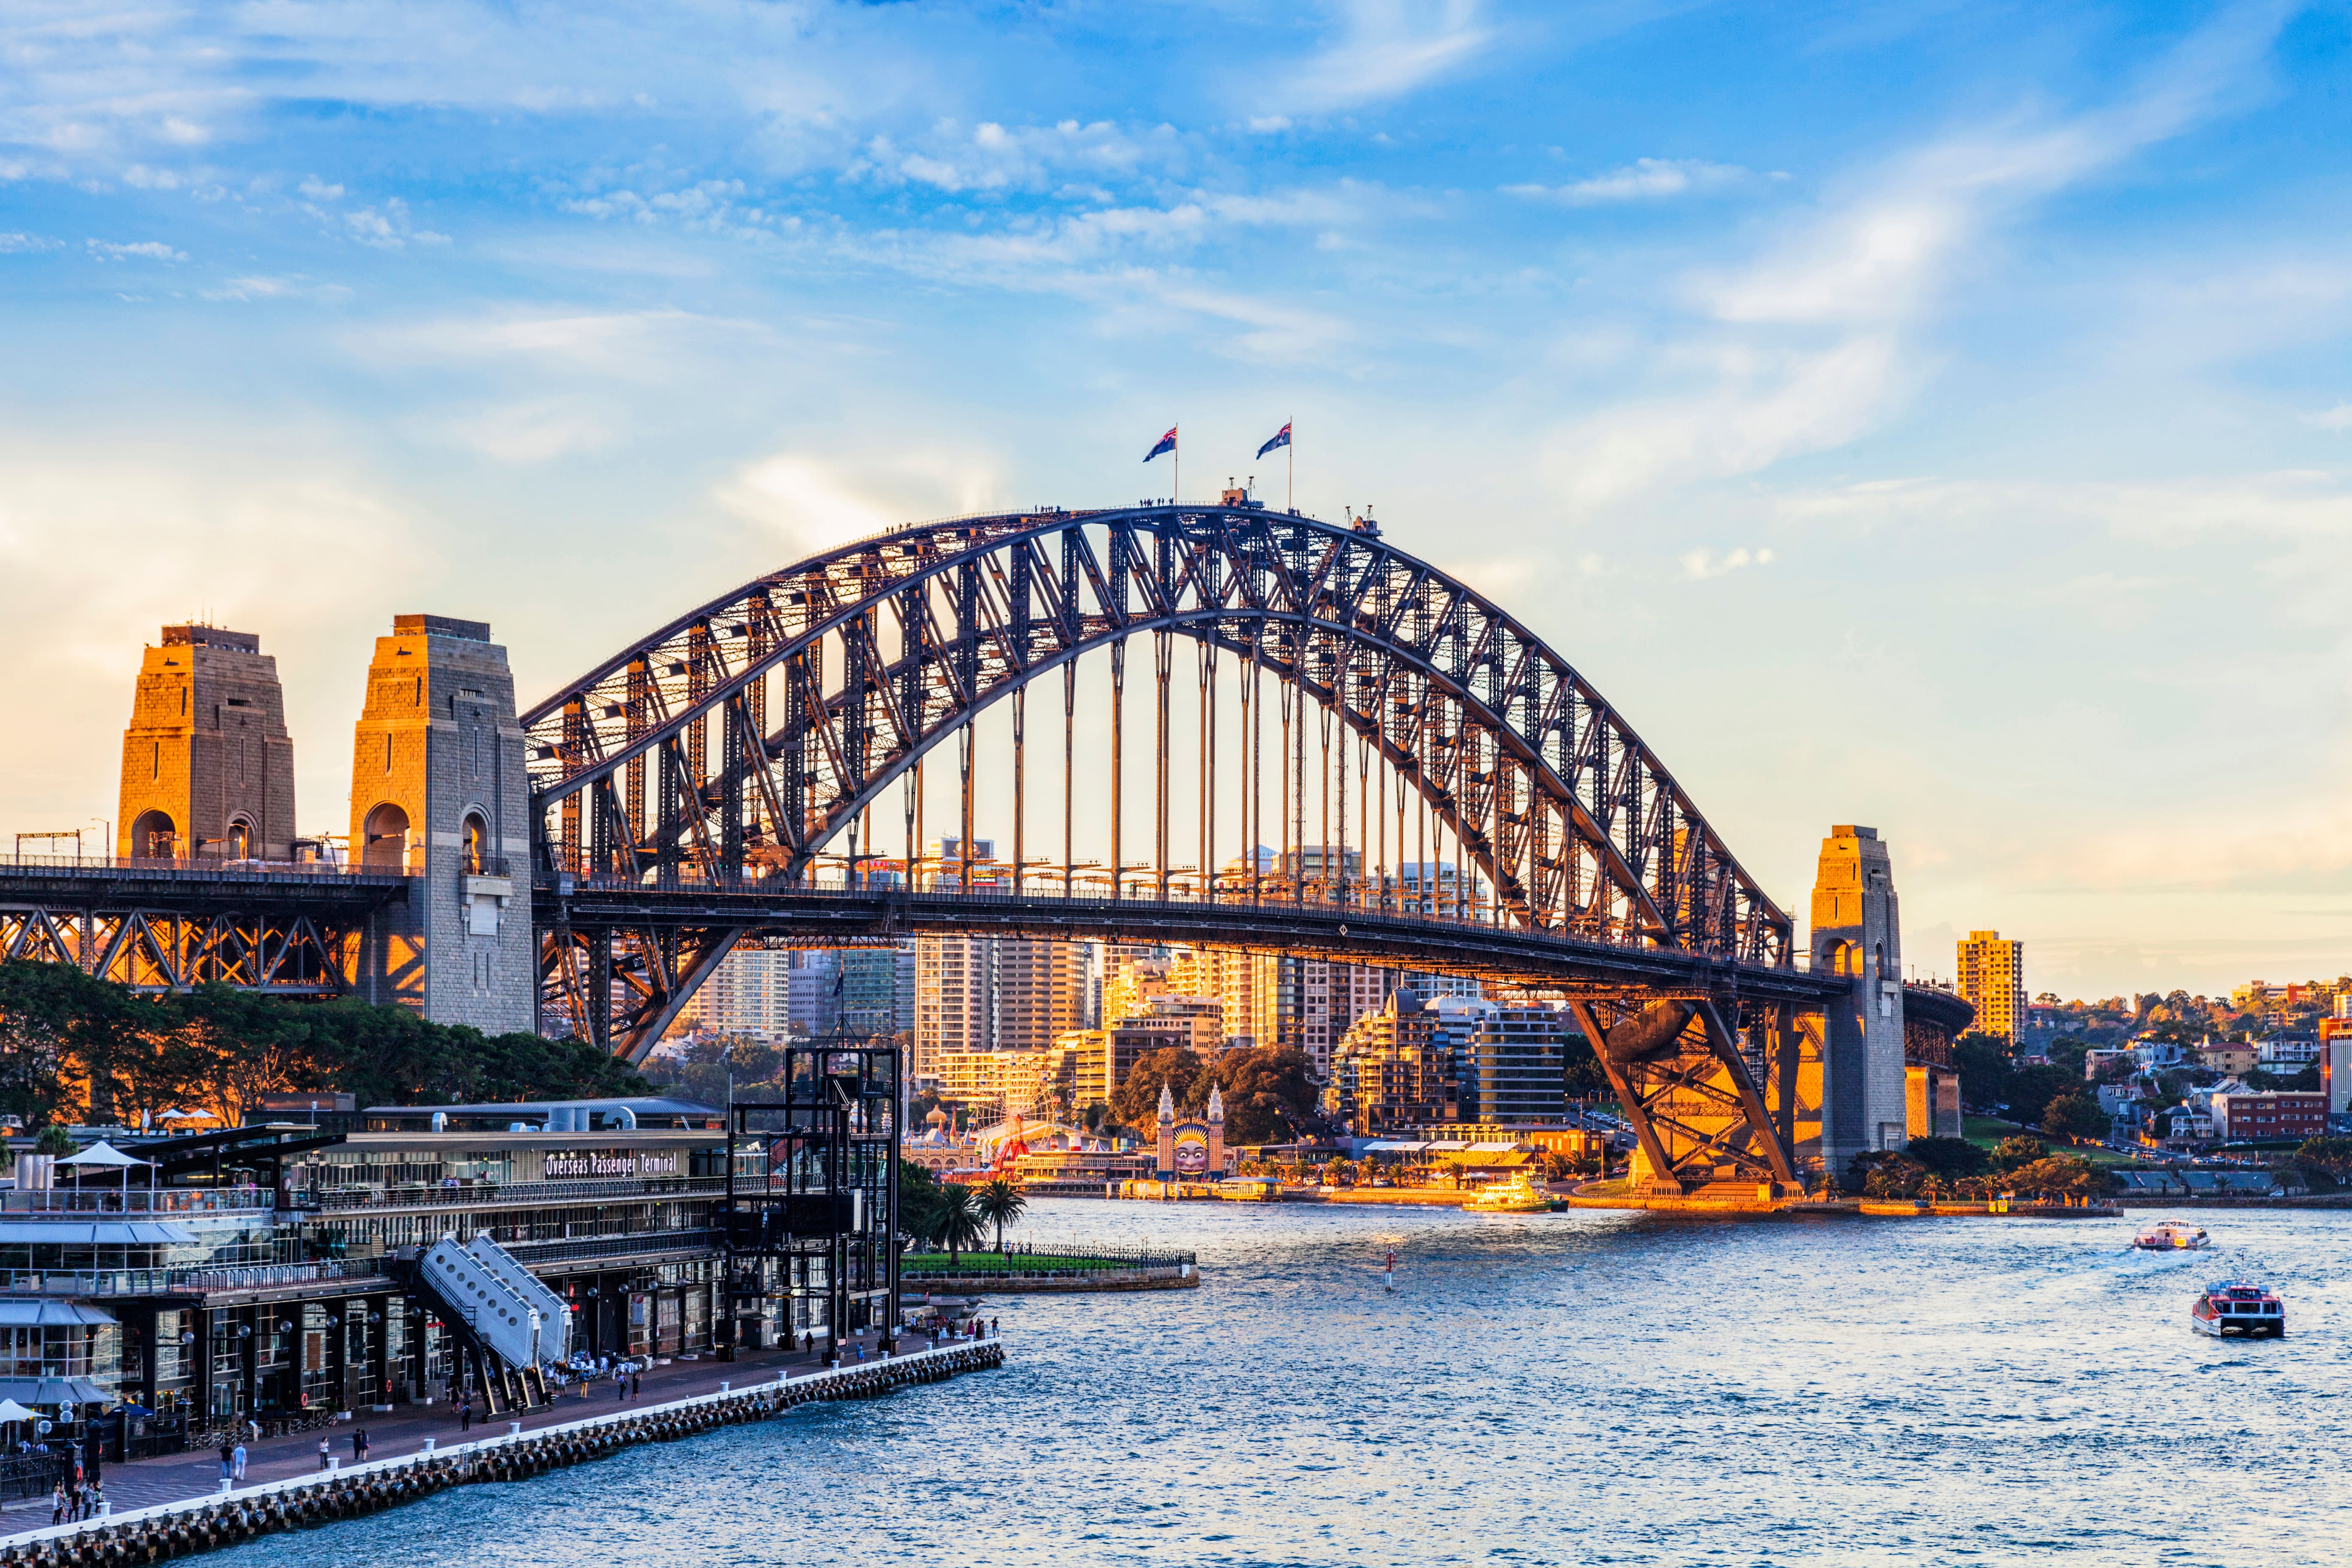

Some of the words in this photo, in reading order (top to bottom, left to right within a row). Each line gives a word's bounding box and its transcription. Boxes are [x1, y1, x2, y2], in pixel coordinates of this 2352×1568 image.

[1175, 1117, 1190, 1127] LUNA
[1192, 1117, 1207, 1127] PARK
[546, 1156, 588, 1175] Overseas
[592, 1155, 636, 1177] Passenger
[640, 1152, 676, 1172] Terminal
